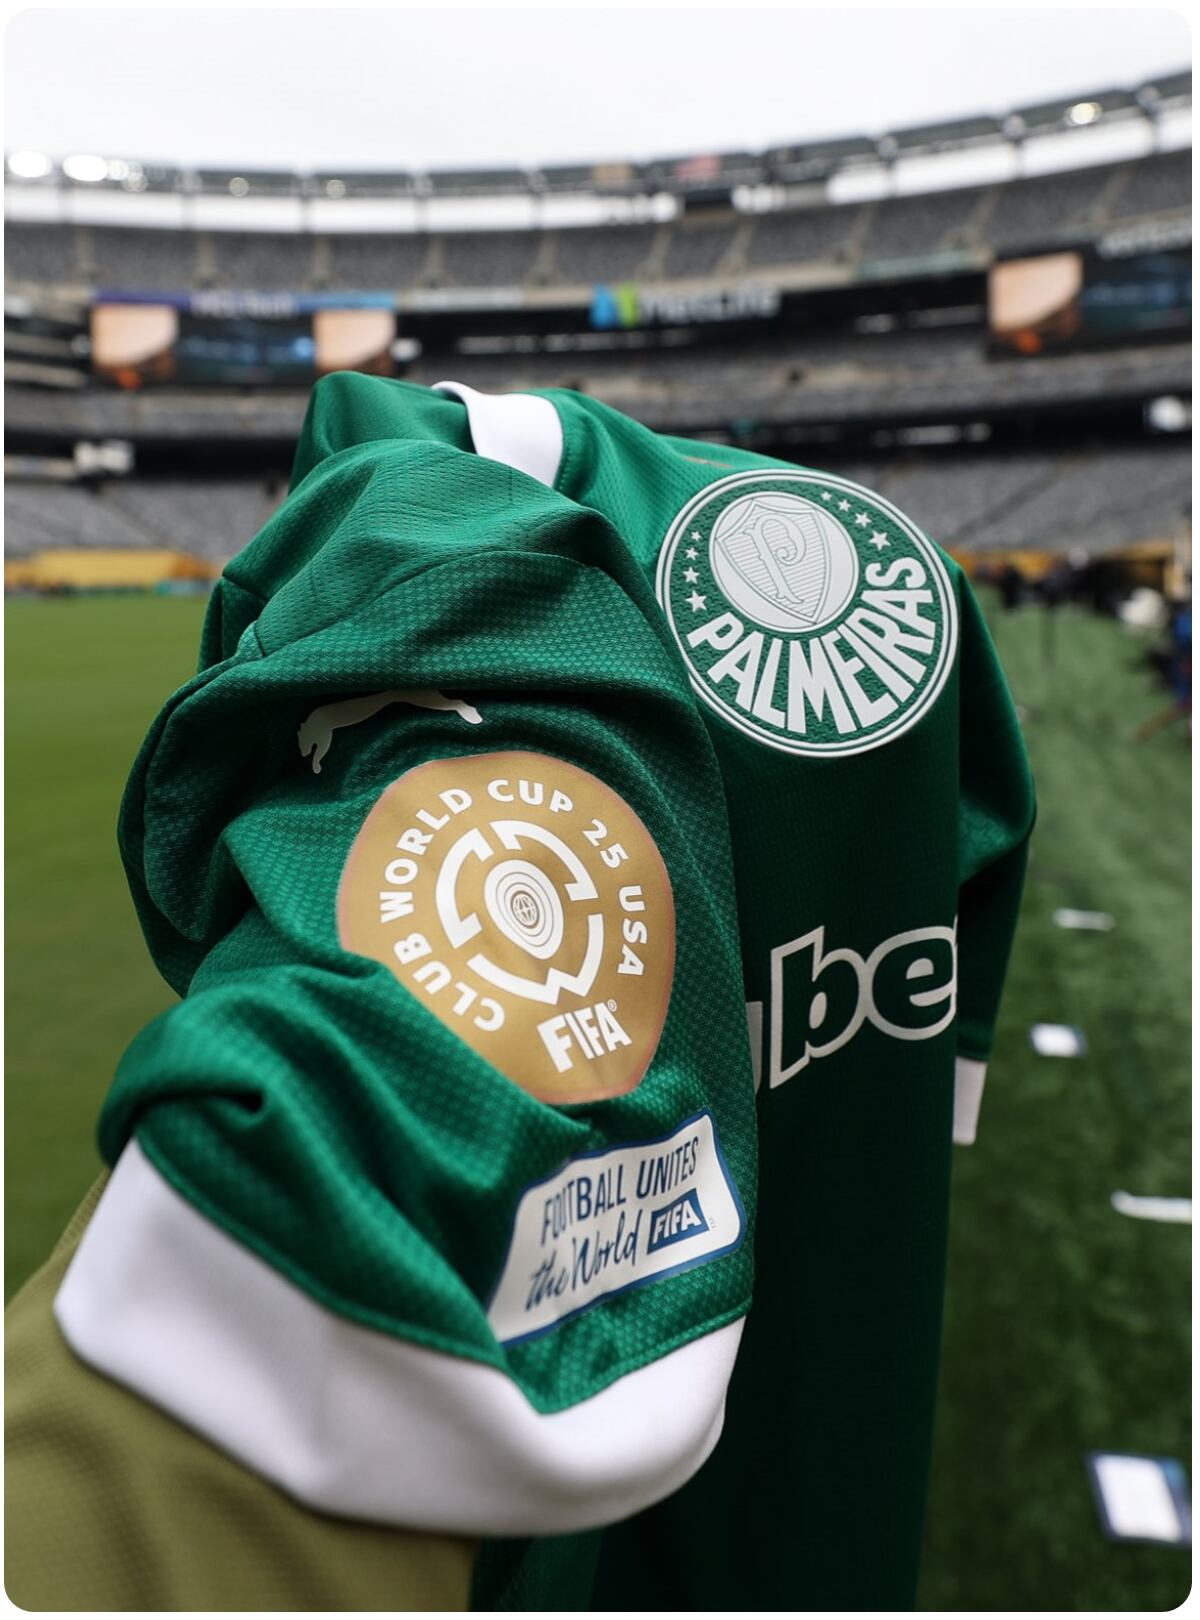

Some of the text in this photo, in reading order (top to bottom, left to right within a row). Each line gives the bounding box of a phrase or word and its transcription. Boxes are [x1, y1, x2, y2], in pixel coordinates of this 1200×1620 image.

[687, 557, 936, 735] PALMEIRAS
[380, 779, 647, 1032] CLUB WORLD CUP 25 USA
[541, 1136, 699, 1246] FOOTBALL UNITES
[652, 1199, 703, 1244] FIFA
[525, 1209, 643, 1312] the World
